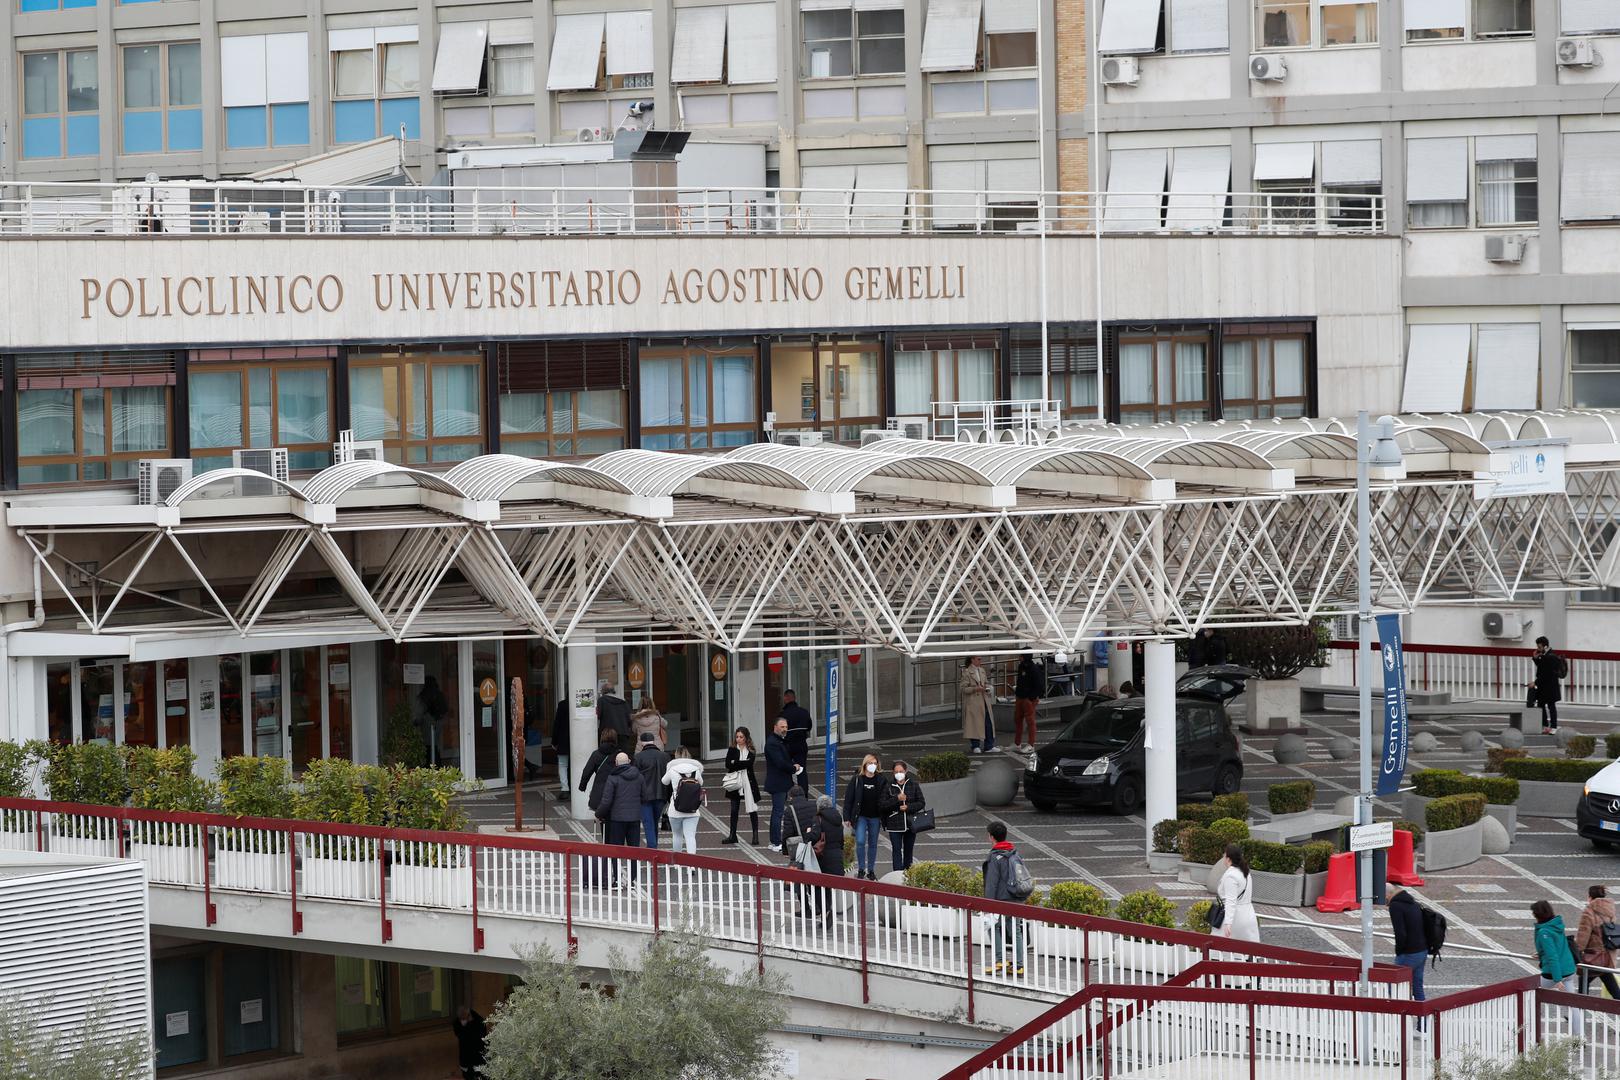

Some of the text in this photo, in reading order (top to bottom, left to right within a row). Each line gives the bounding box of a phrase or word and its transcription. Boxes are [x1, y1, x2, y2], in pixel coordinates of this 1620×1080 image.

[79, 265, 966, 319] POLICLINICO UNIVERSITARIO AGOSTINO GEMELLI
[1383, 687, 1399, 774] Gemelli
